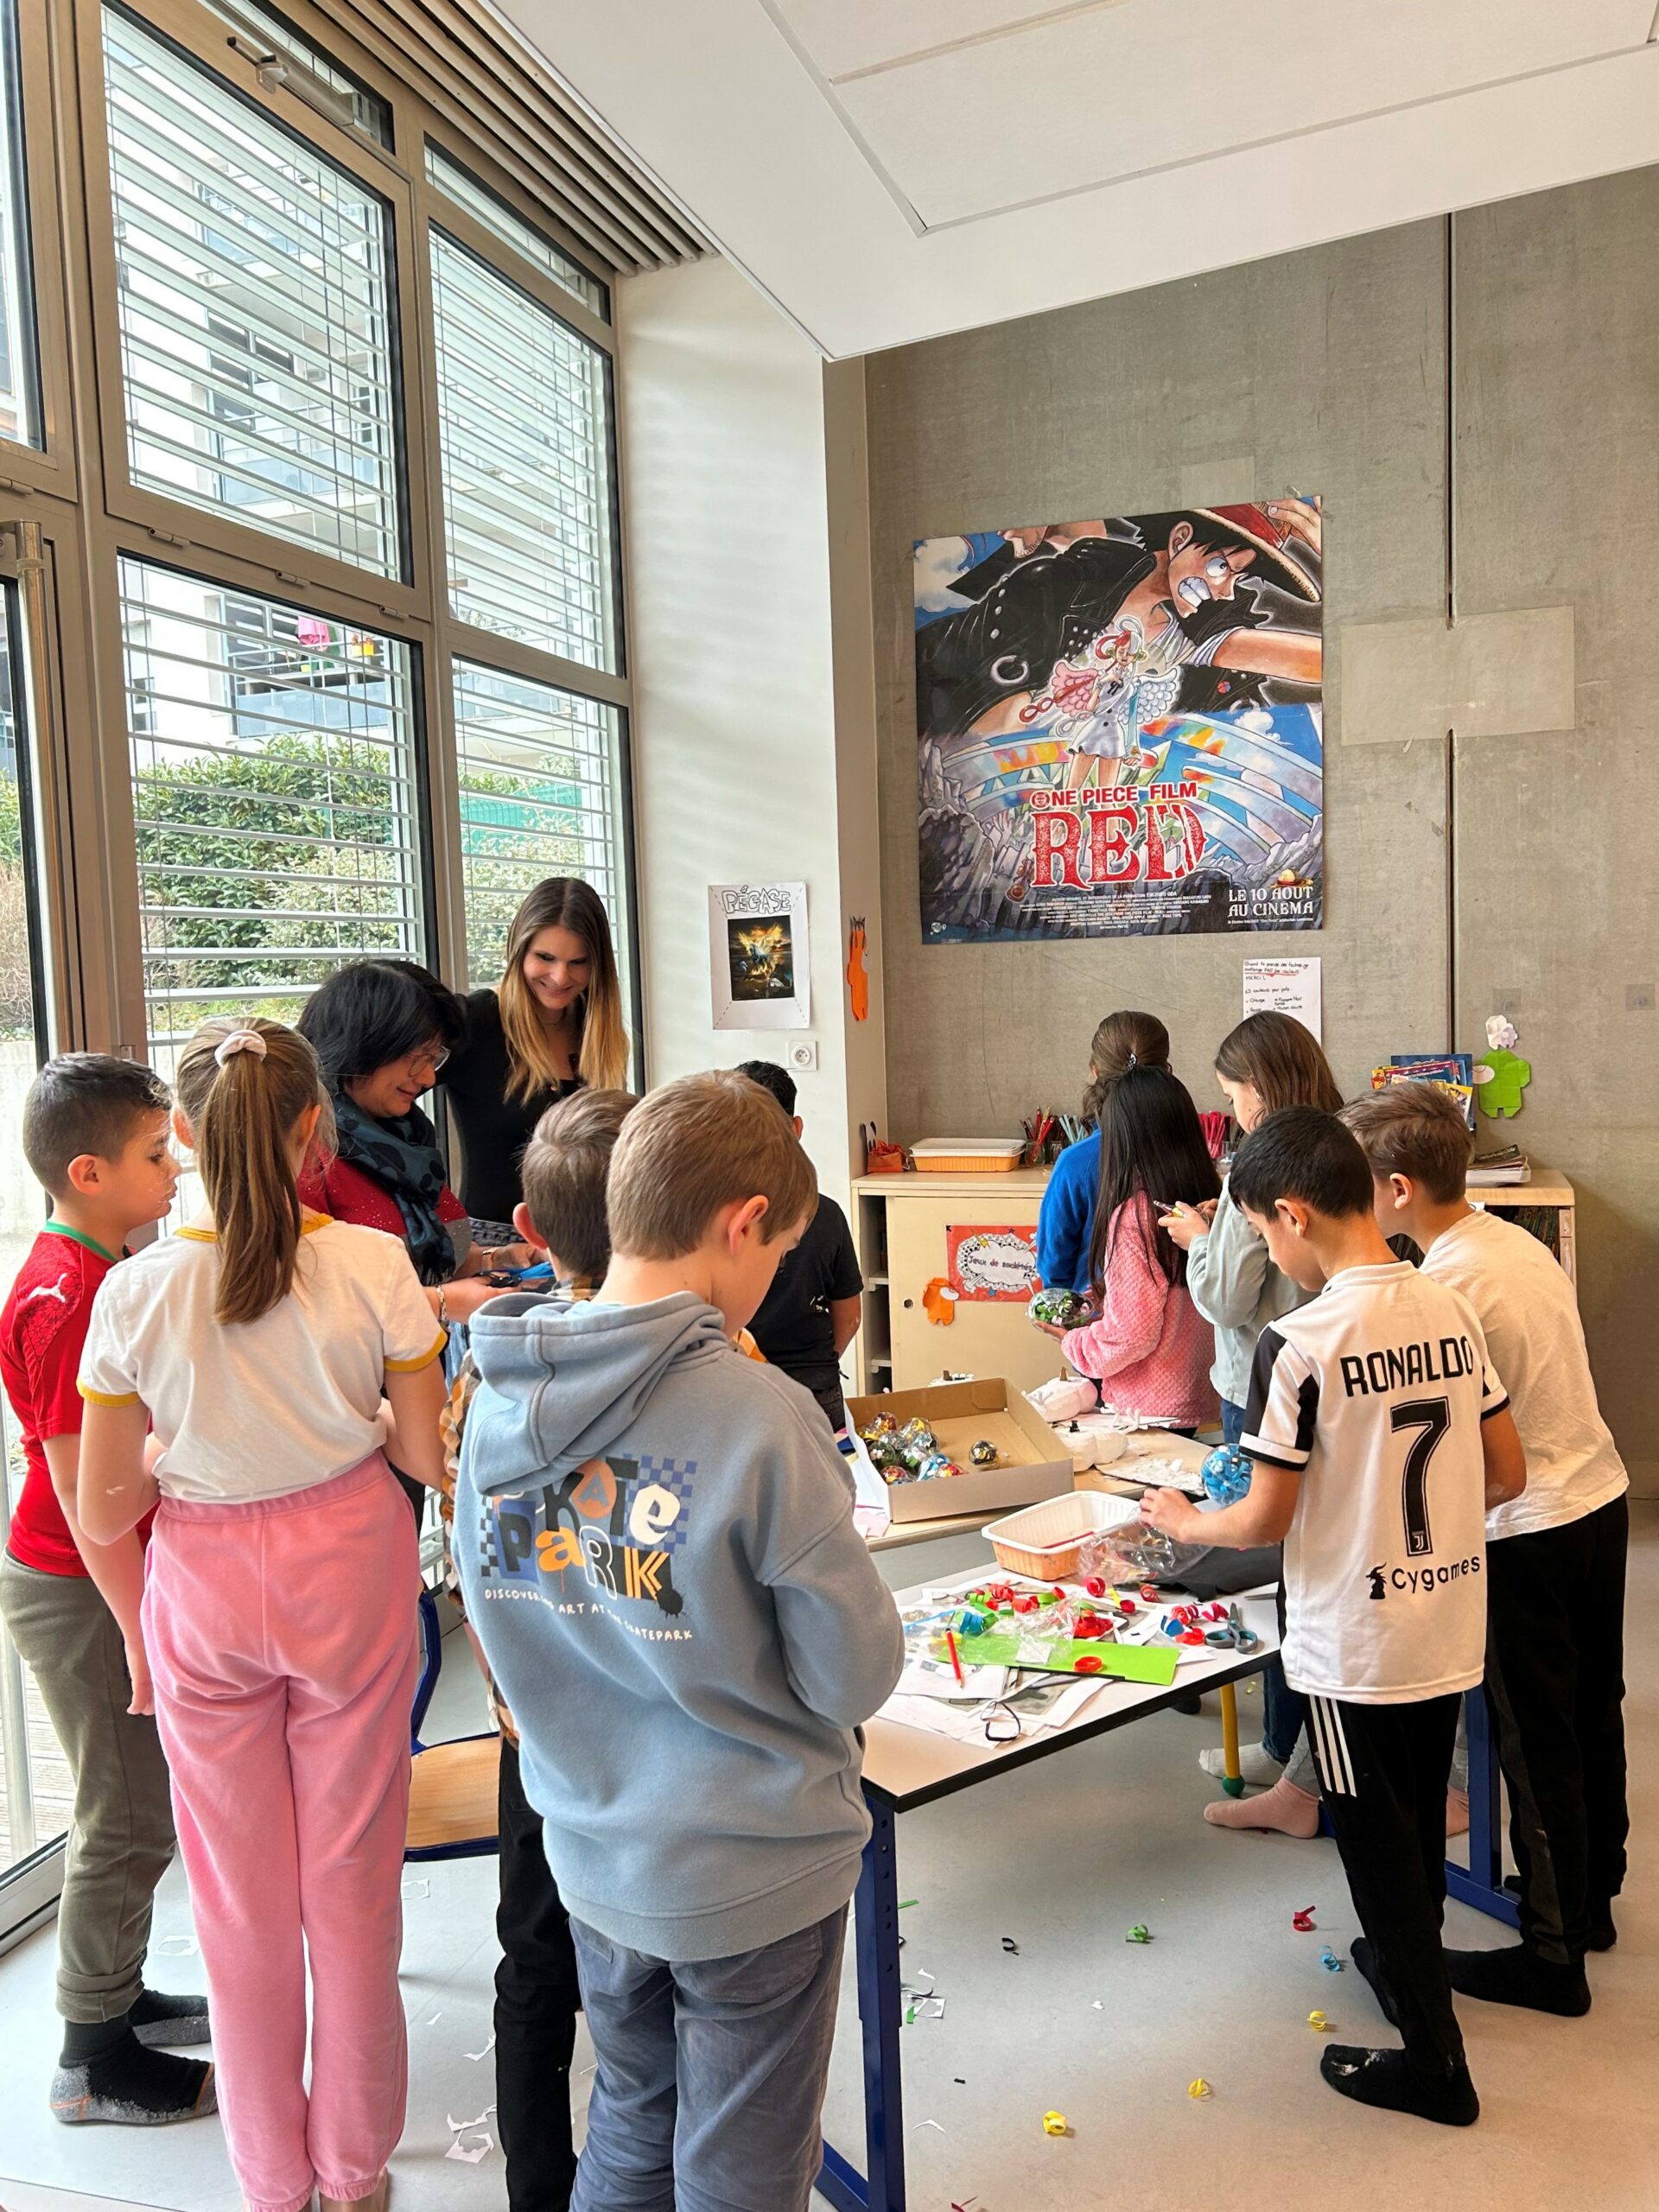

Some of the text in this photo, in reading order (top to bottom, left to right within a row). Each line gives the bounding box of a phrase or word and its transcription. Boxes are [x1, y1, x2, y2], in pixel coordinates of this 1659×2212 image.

[1030, 782, 1198, 809] ONE PIECE FILM
[1030, 804, 1209, 890] RED
[722, 885, 791, 914] PÉGASE
[1229, 889, 1247, 902] LE
[1250, 887, 1268, 900] 10
[1229, 904, 1249, 917] AU
[1340, 1336, 1474, 1397] RONALDO
[1391, 1395, 1452, 1557] 7
[537, 1459, 681, 1546] KATe
[1391, 1556, 1481, 1594] Cygames
[558, 1603, 585, 1615] ART
[592, 1604, 605, 1614] AT
